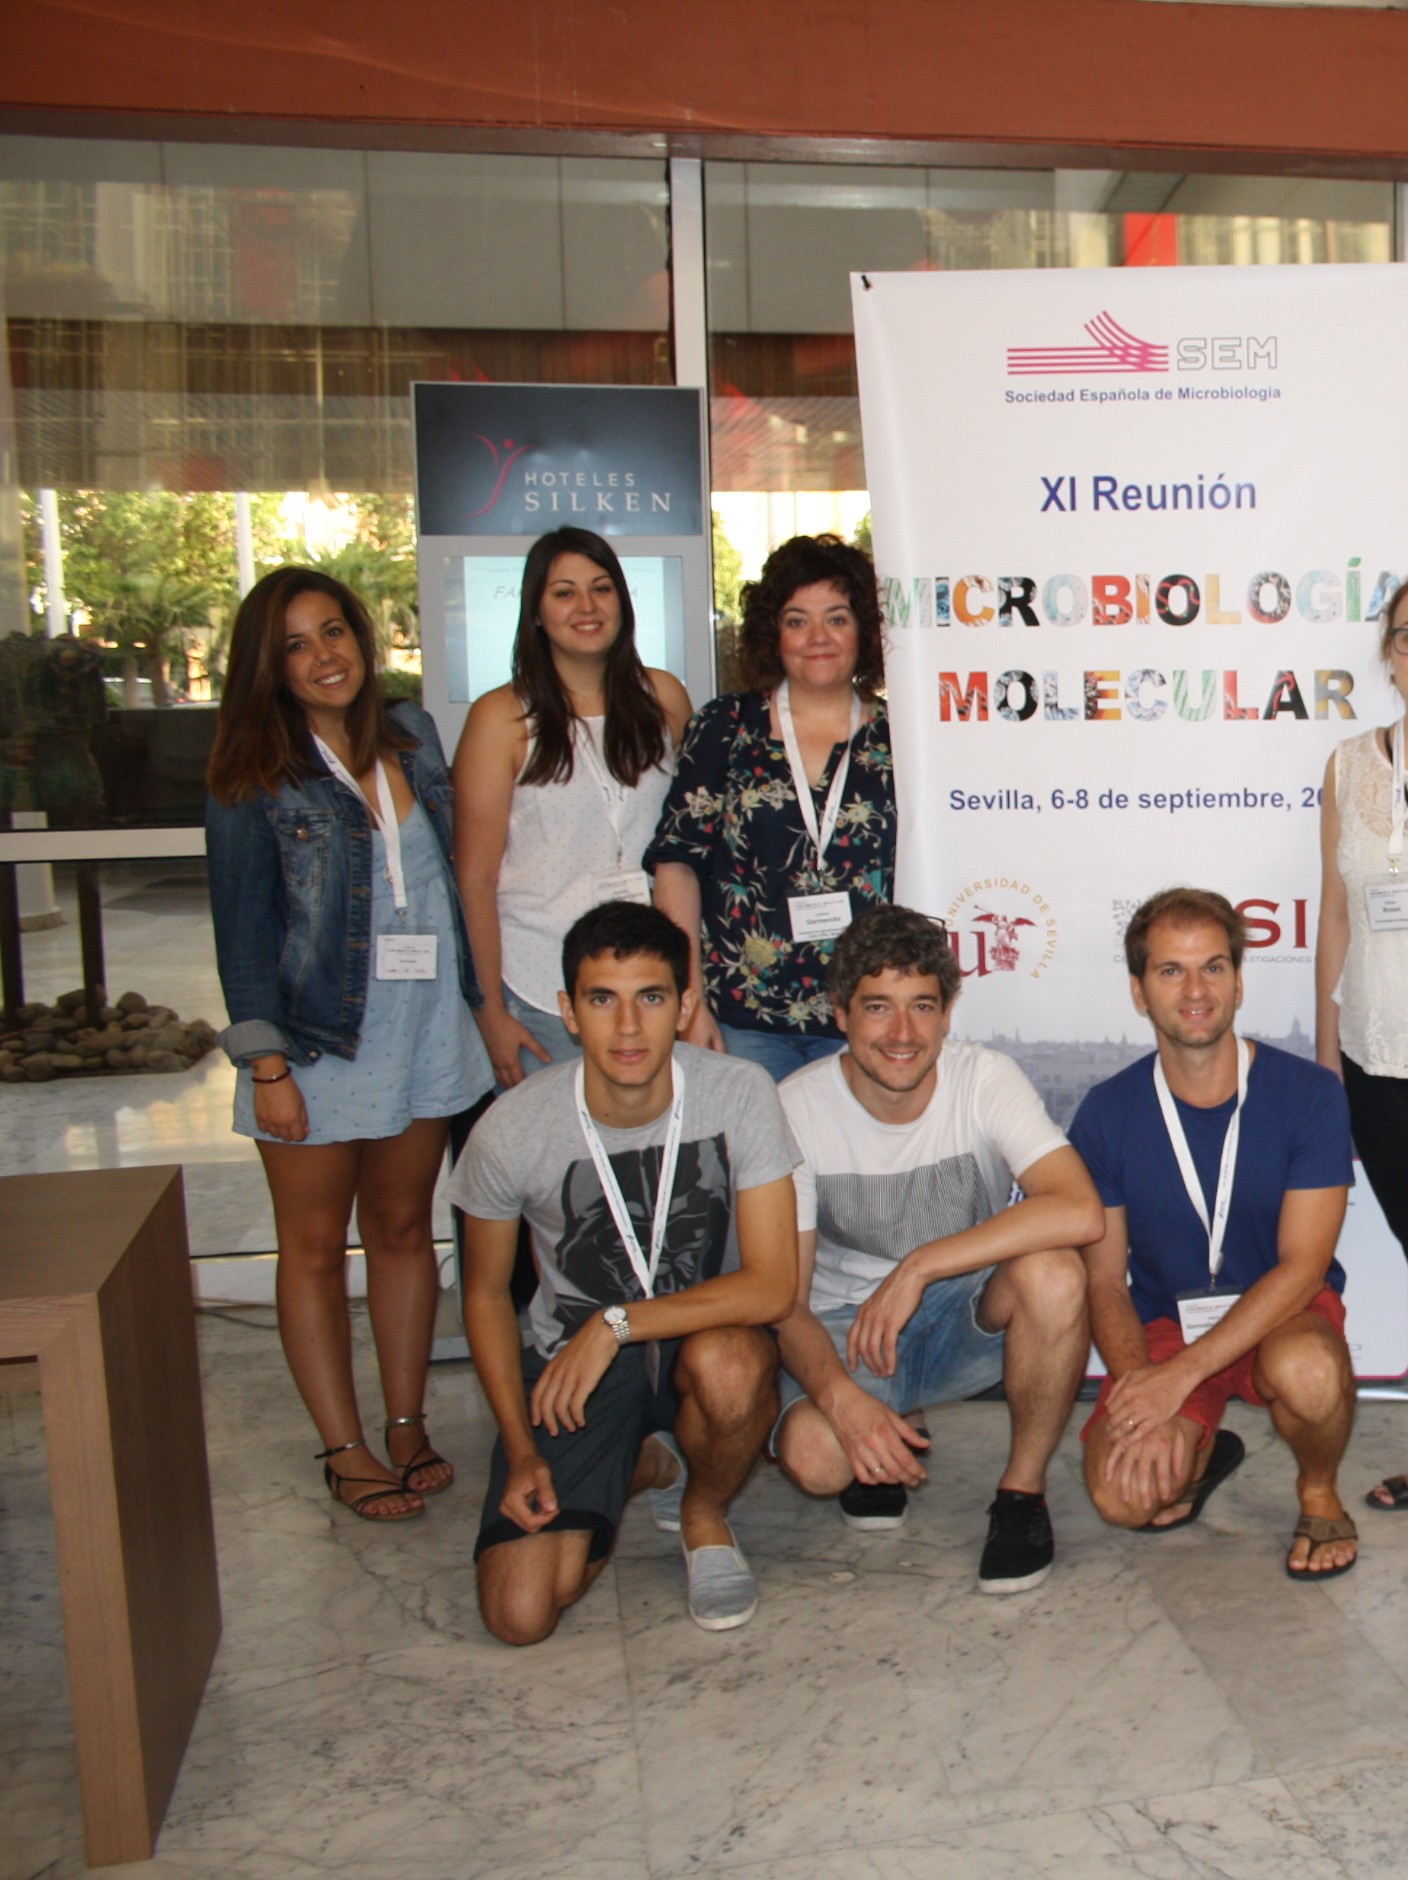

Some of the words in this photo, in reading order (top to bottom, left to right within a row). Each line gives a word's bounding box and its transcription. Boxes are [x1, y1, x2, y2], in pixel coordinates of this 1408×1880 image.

[1176, 336, 1278, 371] SEM
[1005, 388, 1075, 404] Sociedad
[1079, 388, 1150, 405] Española
[1155, 387, 1173, 401] de
[1178, 385, 1281, 403] Microbiología
[524, 472, 636, 487] HOTELES
[1040, 476, 1077, 513] XI
[1092, 473, 1257, 512] Reunión
[524, 491, 673, 513] SILKEN
[938, 668, 1358, 722] MOLECULAR
[949, 789, 1042, 812] Sevilla,
[1051, 789, 1089, 809] 6-8
[1098, 788, 1129, 809] de
[1138, 787, 1292, 814] septiembre,
[945, 877, 1031, 927] UNIVERSIDAD
[1032, 894, 1050, 914] DE
[1029, 918, 1058, 980] SEVILLA
